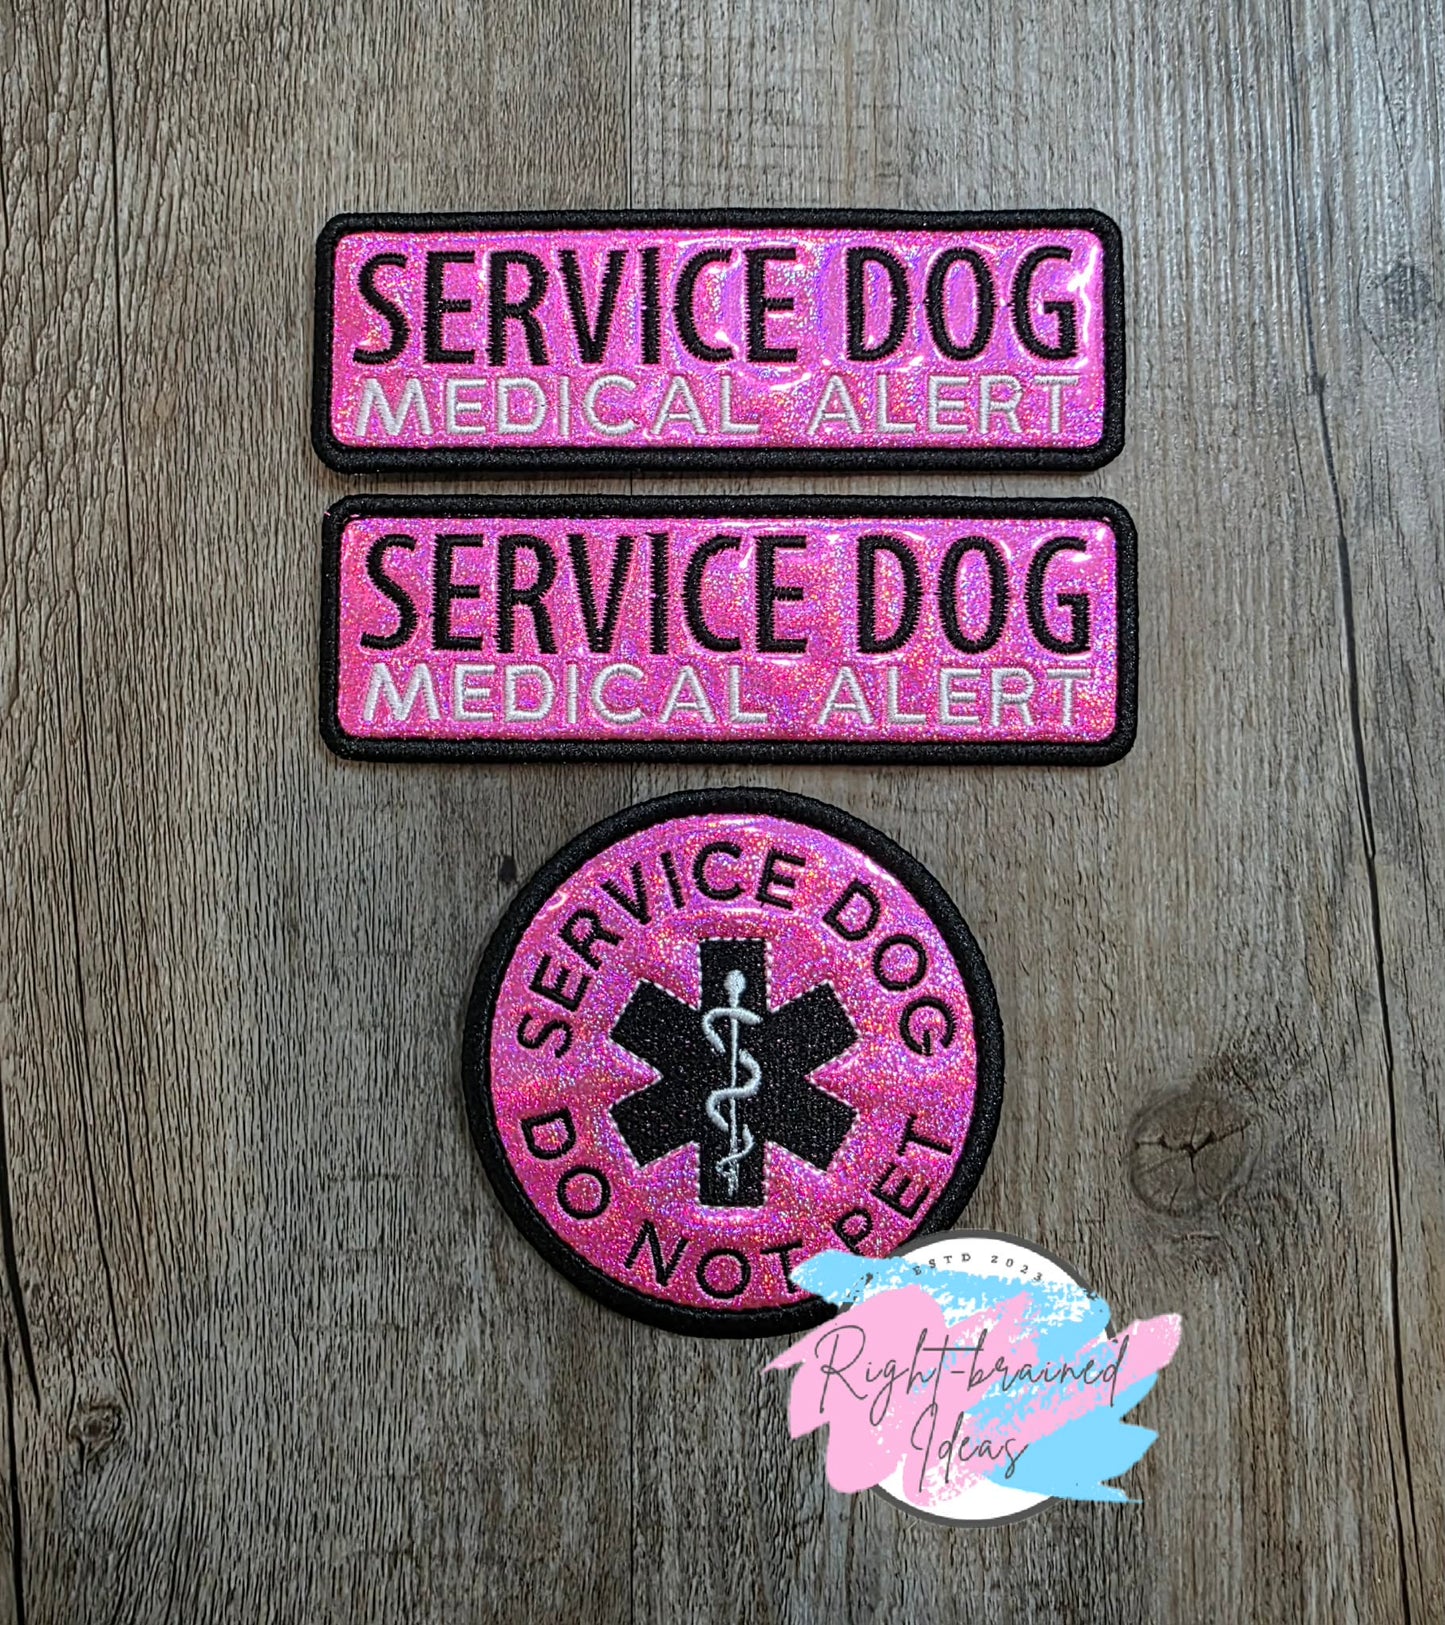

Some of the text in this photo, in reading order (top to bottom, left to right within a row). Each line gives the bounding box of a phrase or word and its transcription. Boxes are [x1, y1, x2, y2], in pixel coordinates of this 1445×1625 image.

[352, 246, 1080, 367] SERVICE DOG
[354, 374, 1079, 438] MEDICAL ALERT
[359, 532, 1092, 655] SERVICE DOG
[362, 663, 1092, 728] MEDICAL ALERT
[516, 841, 958, 1058] SERVICE DOG
[521, 1108, 956, 1300] DO NOT PET
